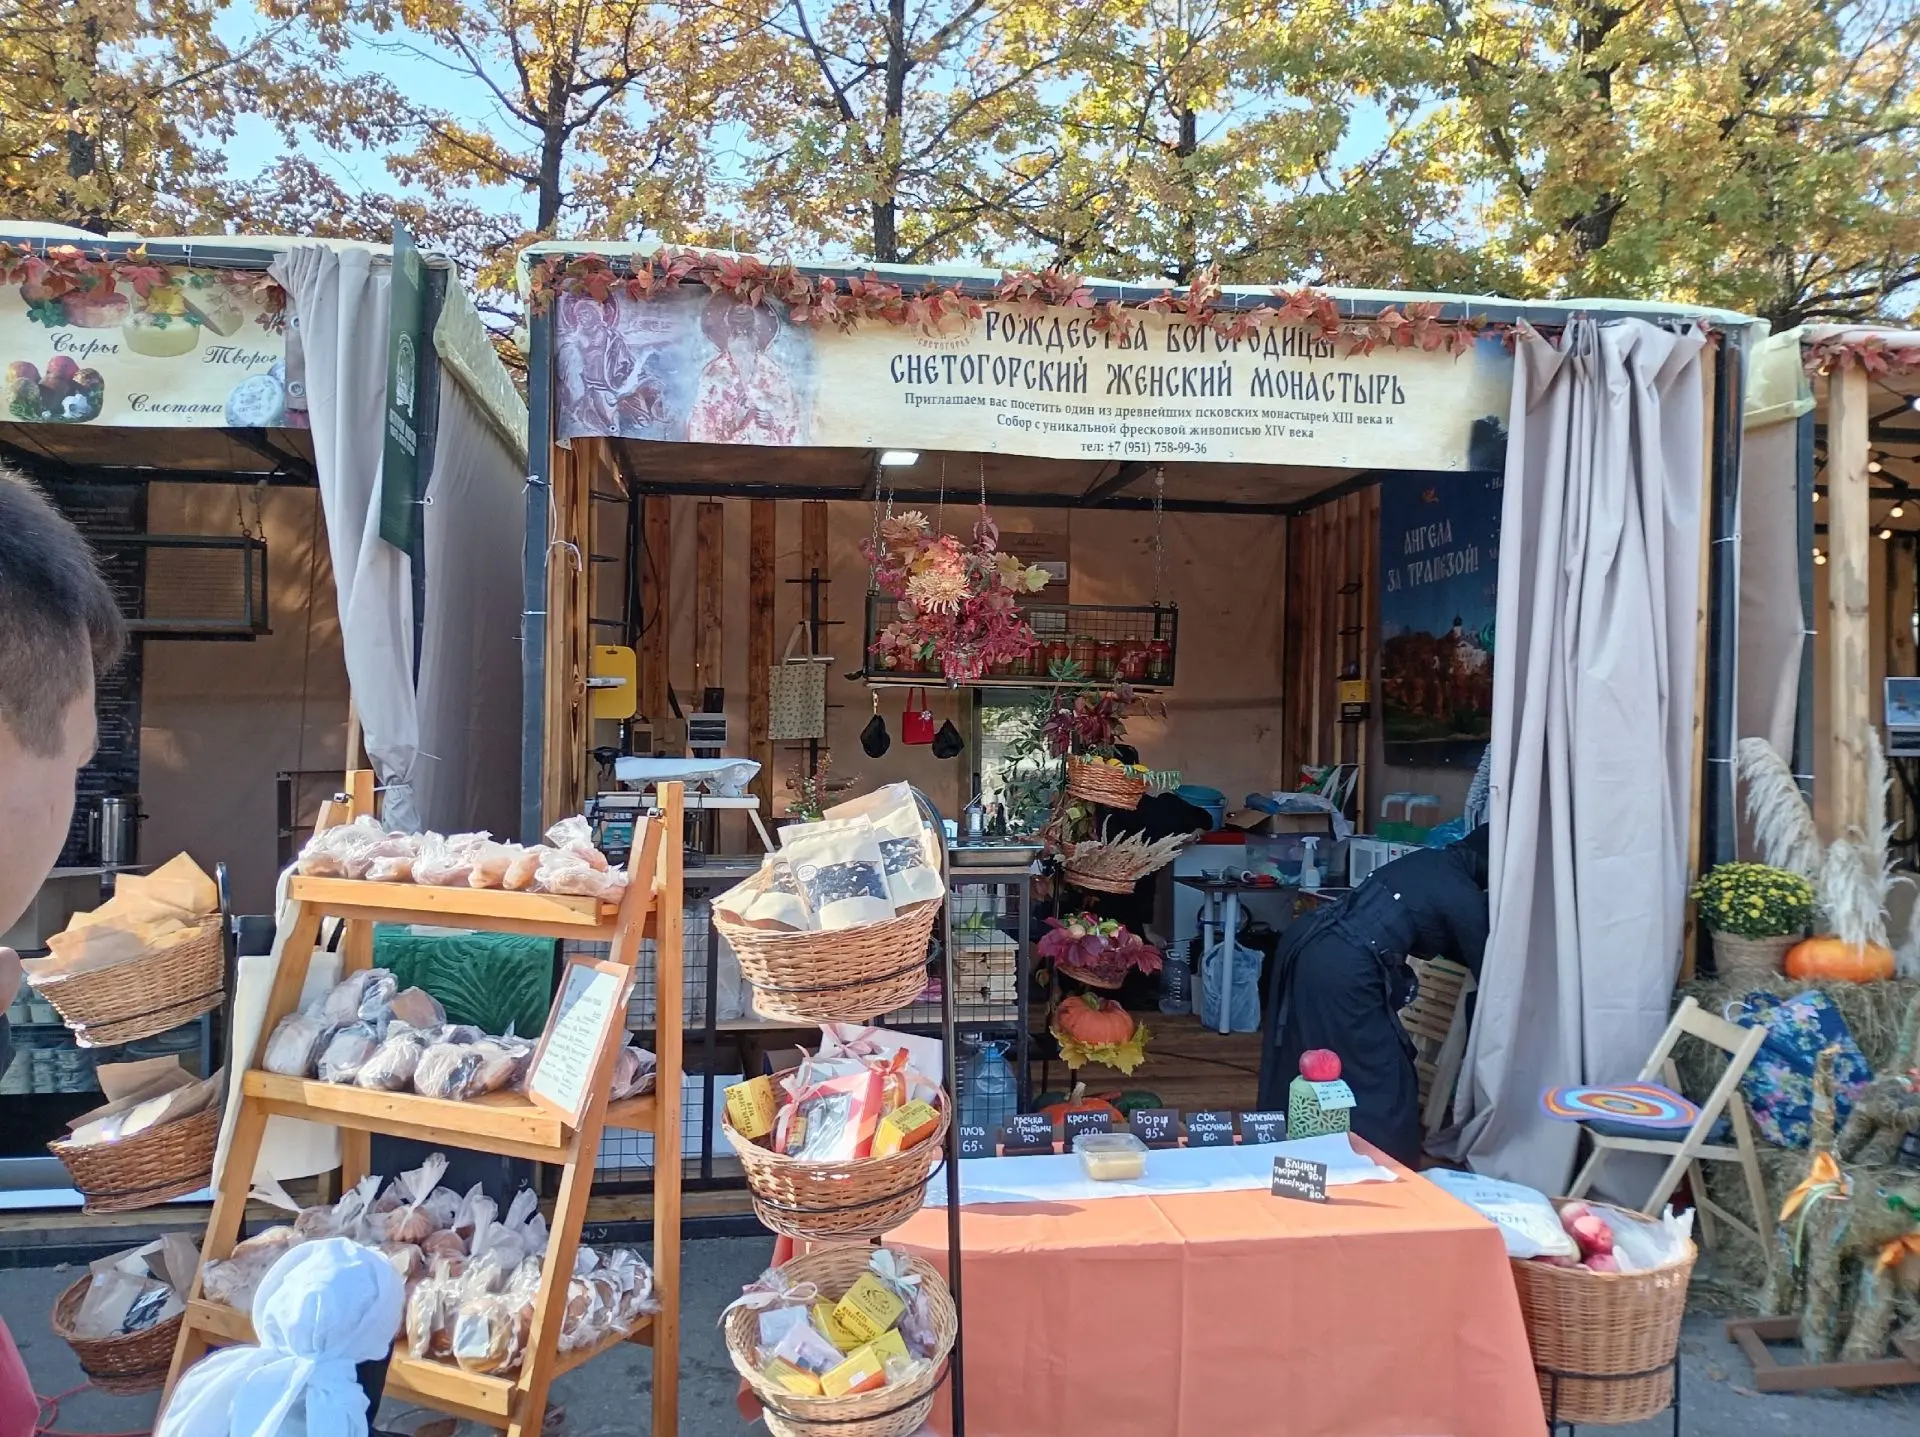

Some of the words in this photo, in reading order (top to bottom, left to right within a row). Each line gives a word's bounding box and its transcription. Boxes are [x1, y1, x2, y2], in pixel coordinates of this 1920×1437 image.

[50, 333, 119, 360] Сыры
[202, 346, 277, 369] Творог
[891, 355, 1087, 394] СНЕТОГОРСКИЙ
[1106, 360, 1232, 397] ЖЕНСКИЙ
[1250, 366, 1405, 405] МОНАСТЫРЬ
[128, 394, 223, 413] Сметана
[905, 392, 986, 407] Приглашаем
[989, 397, 1008, 408] вас
[1011, 400, 1061, 413] посетить
[1065, 404, 1094, 417] один
[1099, 407, 1112, 416] из
[1115, 407, 1191, 418] древнейших
[1196, 408, 1258, 418] псковских
[1262, 409, 1328, 424] монастырей
[1332, 411, 1353, 424] XIII
[1357, 415, 1382, 424] века
[1386, 416, 1393, 424] и
[997, 413, 1032, 431] Собор
[1034, 420, 1041, 429] с
[1043, 421, 1116, 434] уникальной
[1120, 424, 1186, 437] фресковой
[1189, 426, 1261, 437] живописью
[1265, 425, 1286, 437] XIV
[1290, 428, 1314, 438] века
[1081, 442, 1104, 452] тел:
[1124, 440, 1150, 455] (951)
[1155, 441, 1207, 454] 758-99-36
[1404, 518, 1452, 554] АНГЕЛА
[1387, 568, 1402, 592] ЗА
[1408, 543, 1479, 587] ТРАПЕЗОЙ!
